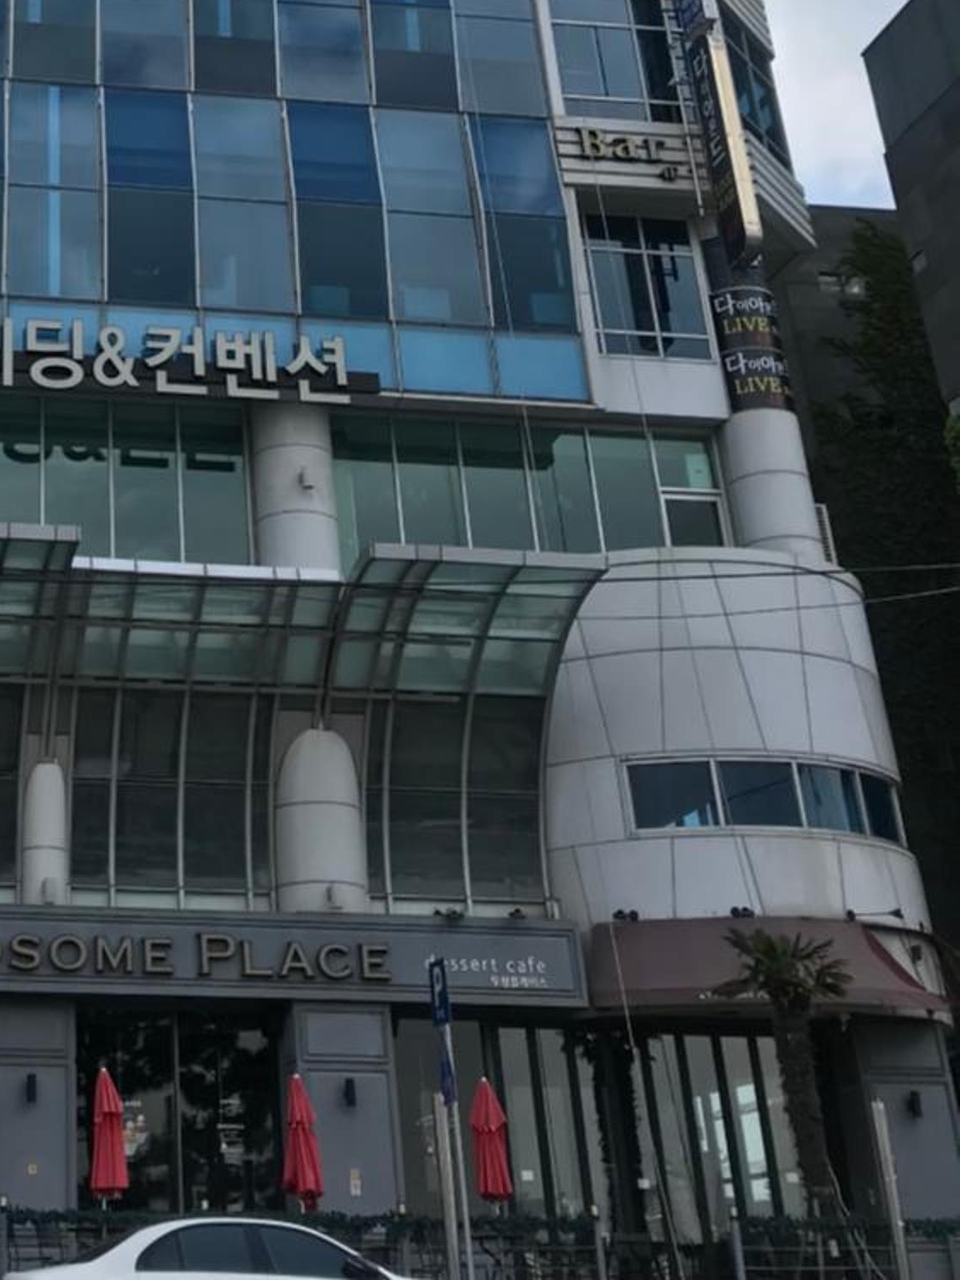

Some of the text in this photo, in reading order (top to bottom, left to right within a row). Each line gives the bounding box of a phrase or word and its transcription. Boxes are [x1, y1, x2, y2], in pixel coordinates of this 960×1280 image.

[576, 126, 666, 163] Bar
[195, 930, 393, 984] PLACE
[425, 954, 547, 974] dssert cafe
